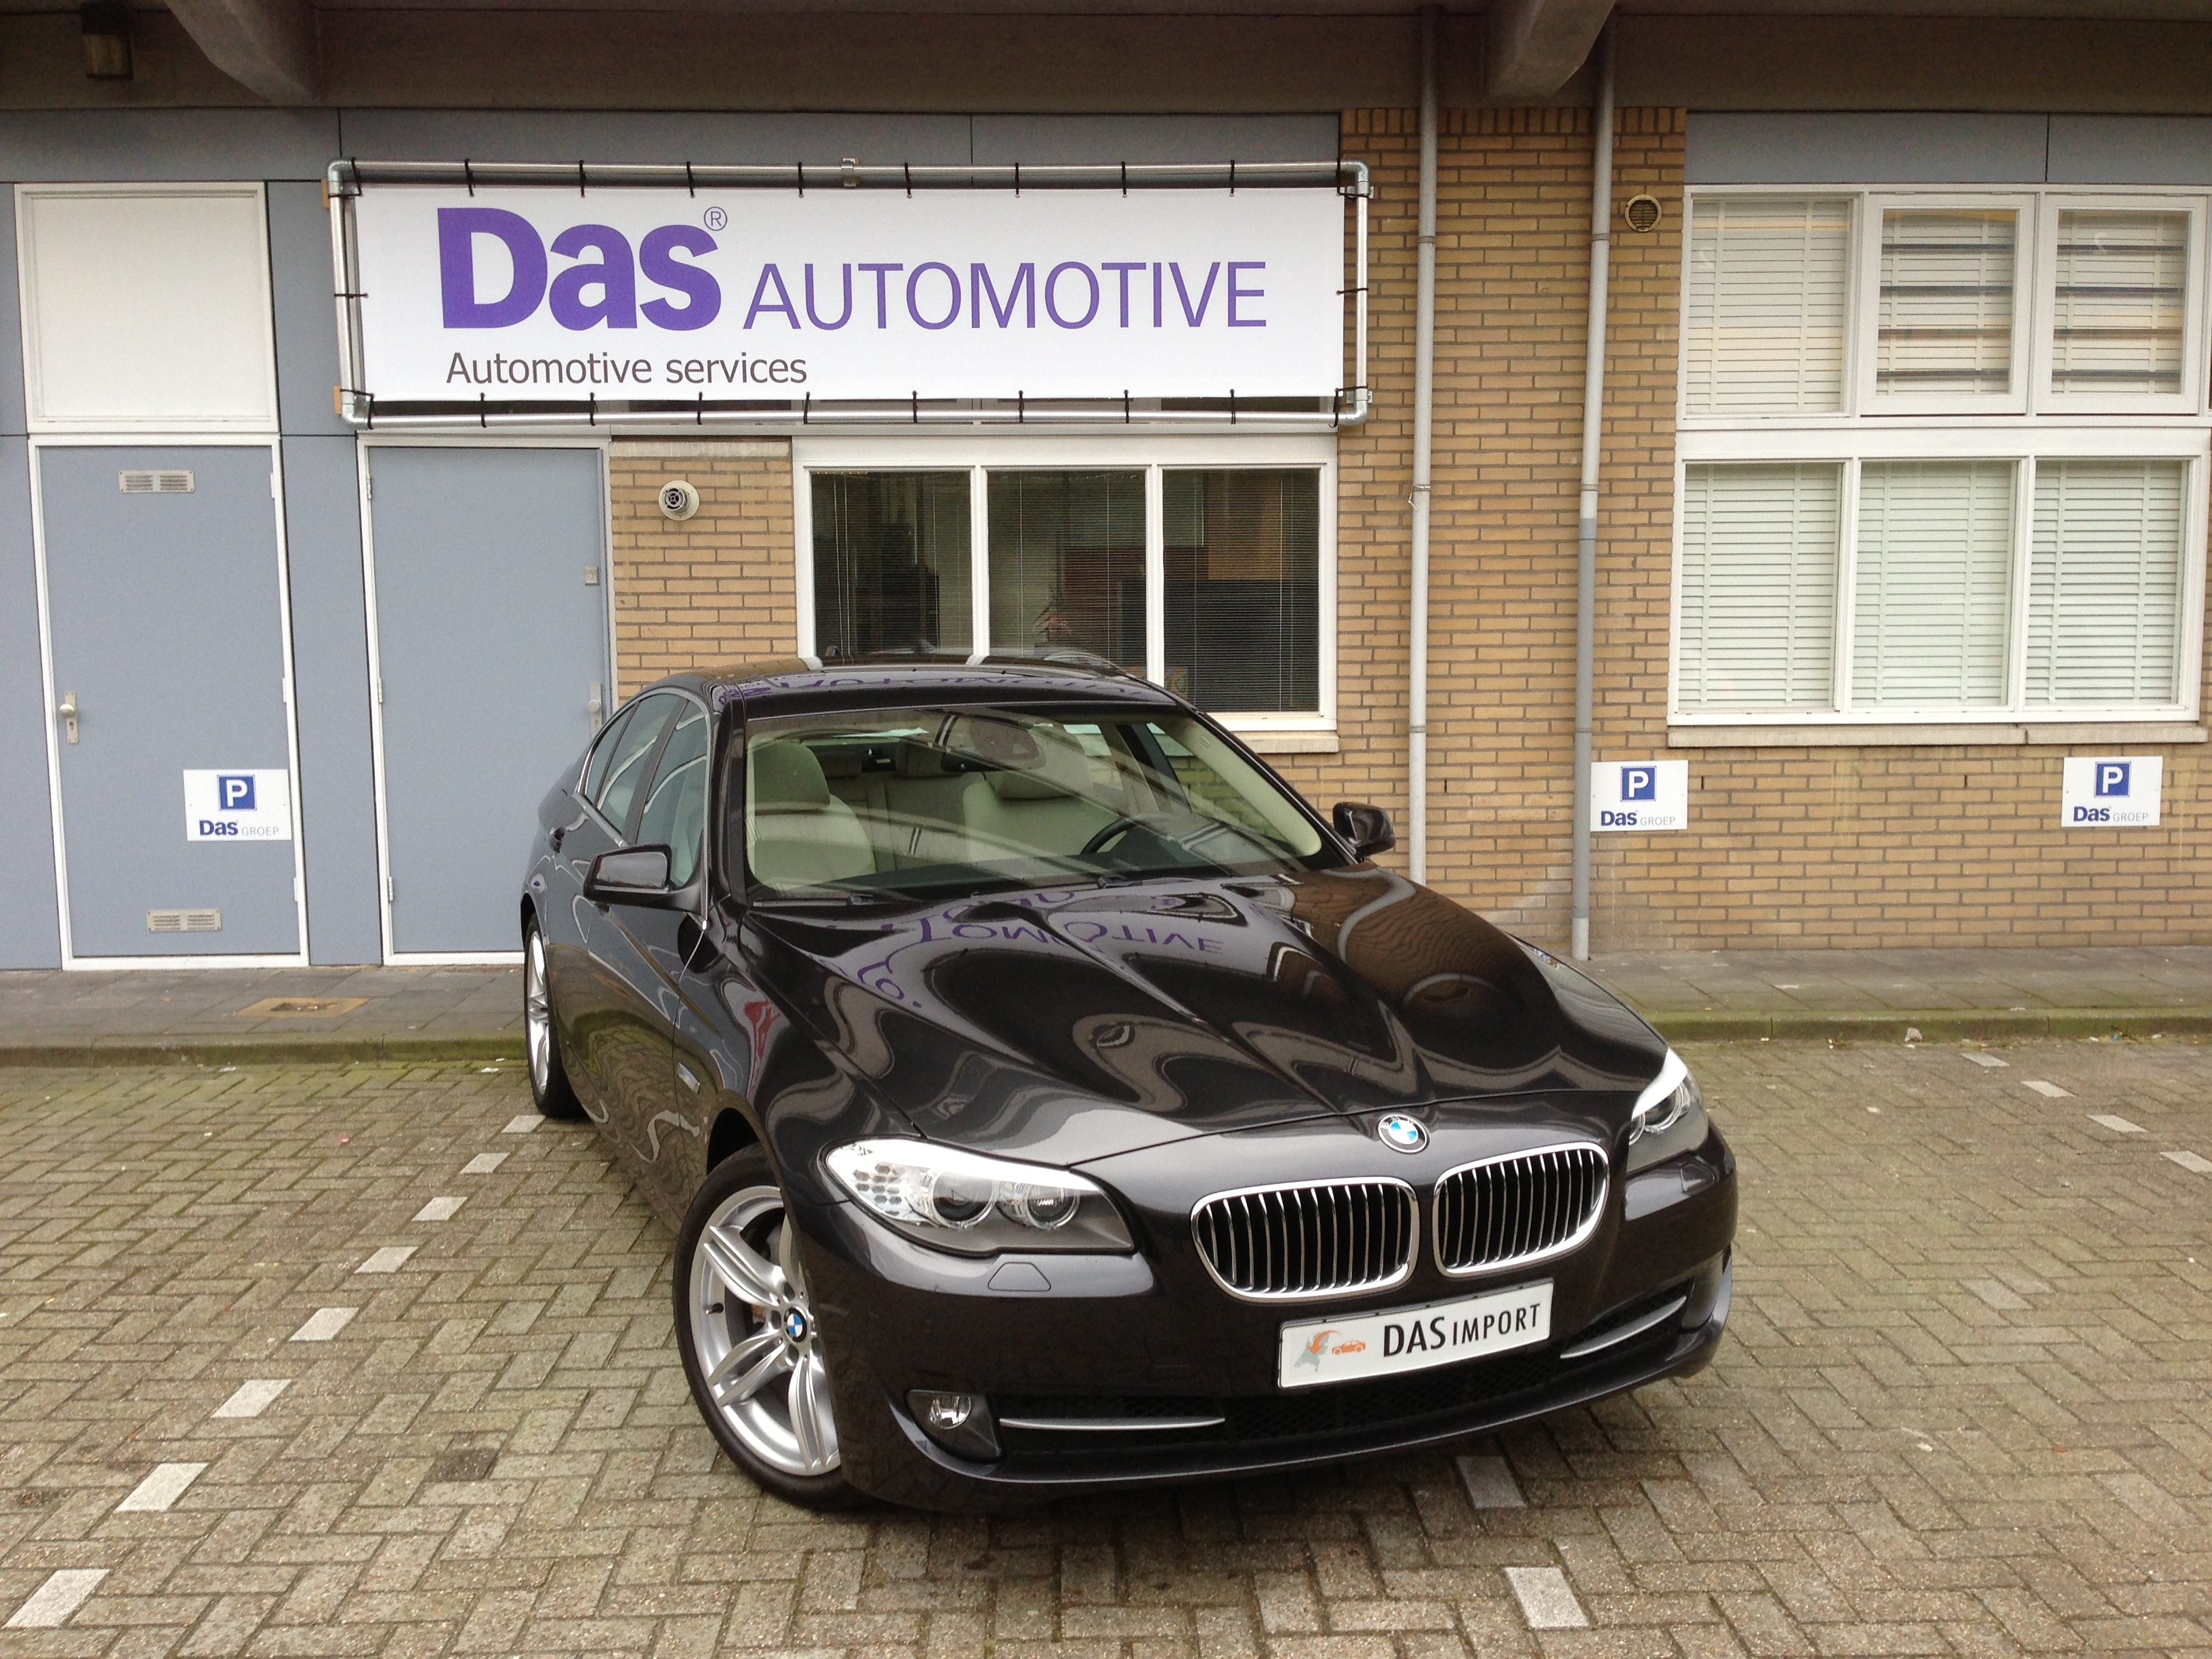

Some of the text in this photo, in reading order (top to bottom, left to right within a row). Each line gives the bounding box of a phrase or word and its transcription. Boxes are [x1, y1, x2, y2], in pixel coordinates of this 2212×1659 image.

[743, 261, 1267, 331] AUTOMOTIVE
[446, 352, 807, 384] Automotive services
[226, 779, 248, 807] P
[1629, 771, 1649, 798] P
[2102, 766, 2123, 794] P
[199, 819, 279, 836] Das GROEP
[1601, 811, 1676, 826] Das GROEP
[2073, 806, 2148, 822] Das GROEP
[1382, 1303, 1541, 1357] DAS IMPORT
